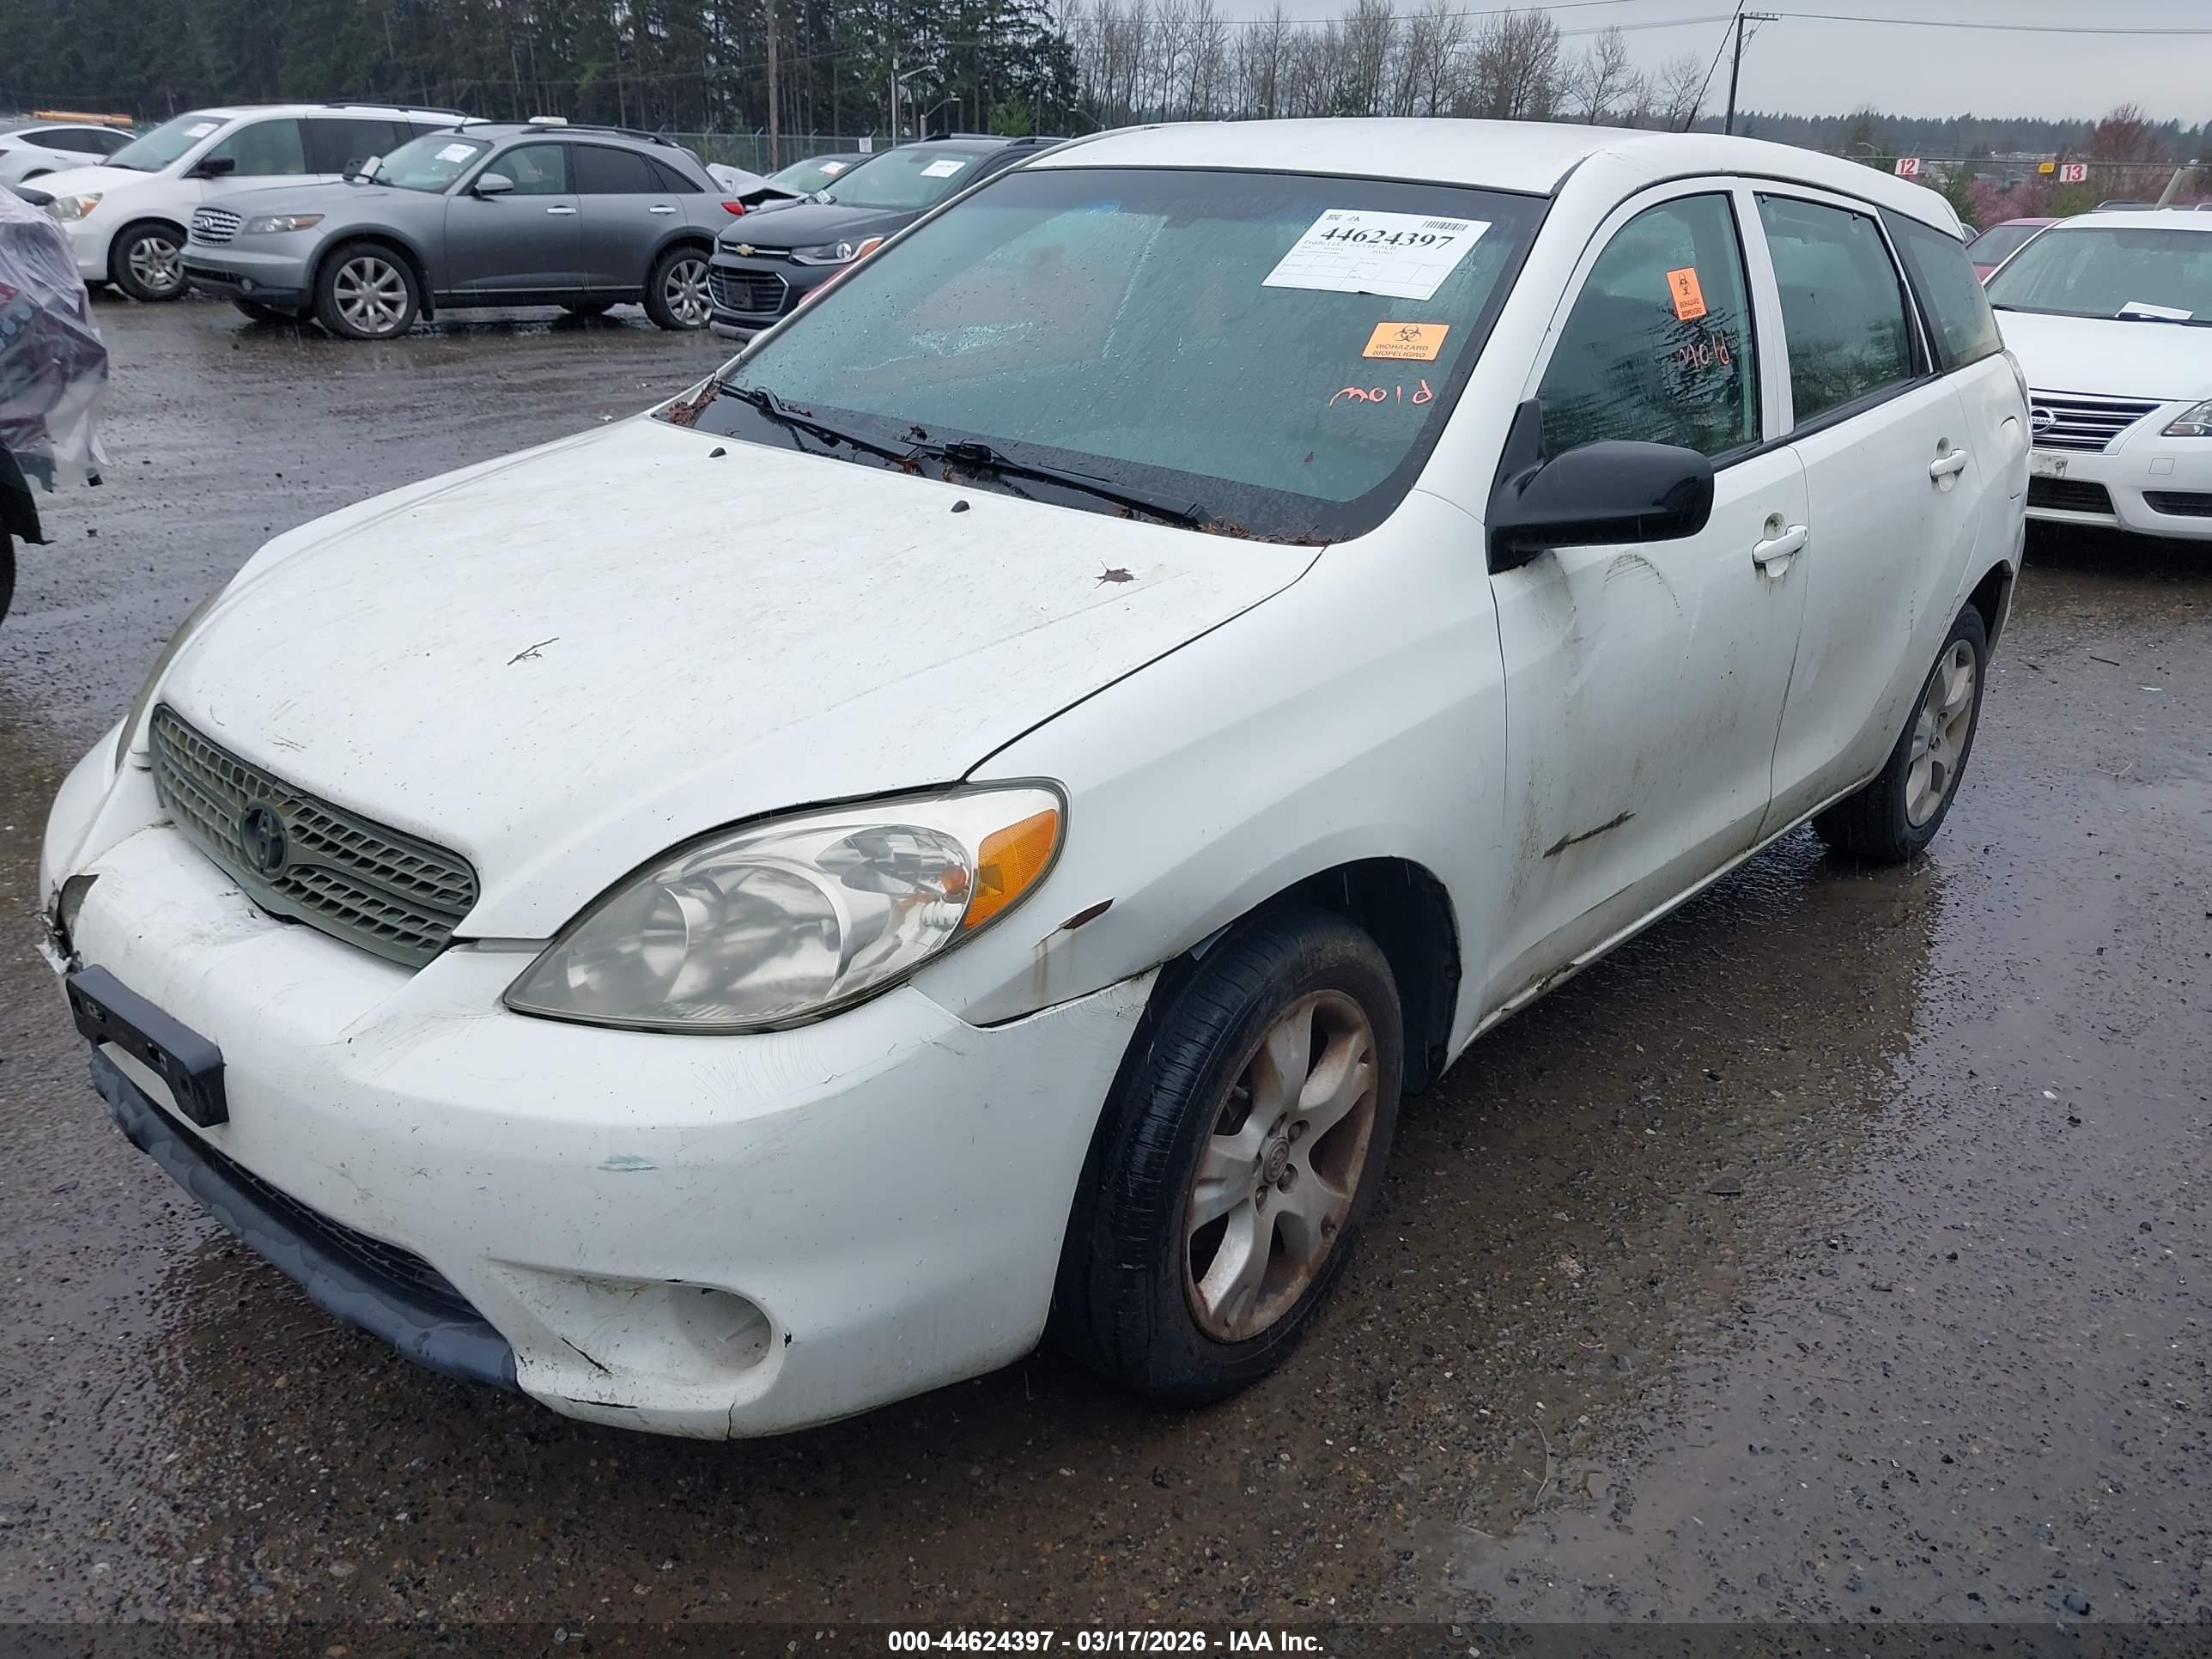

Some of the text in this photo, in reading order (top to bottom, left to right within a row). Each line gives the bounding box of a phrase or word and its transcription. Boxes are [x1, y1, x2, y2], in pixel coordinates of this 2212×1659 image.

[1900, 159, 1916, 174] 12
[2065, 164, 2083, 180] 13
[1320, 227, 1456, 250] 44624397
[1679, 298, 1700, 308] BIOHAZARD
[1681, 307, 1704, 318] BIOPELIGRO
